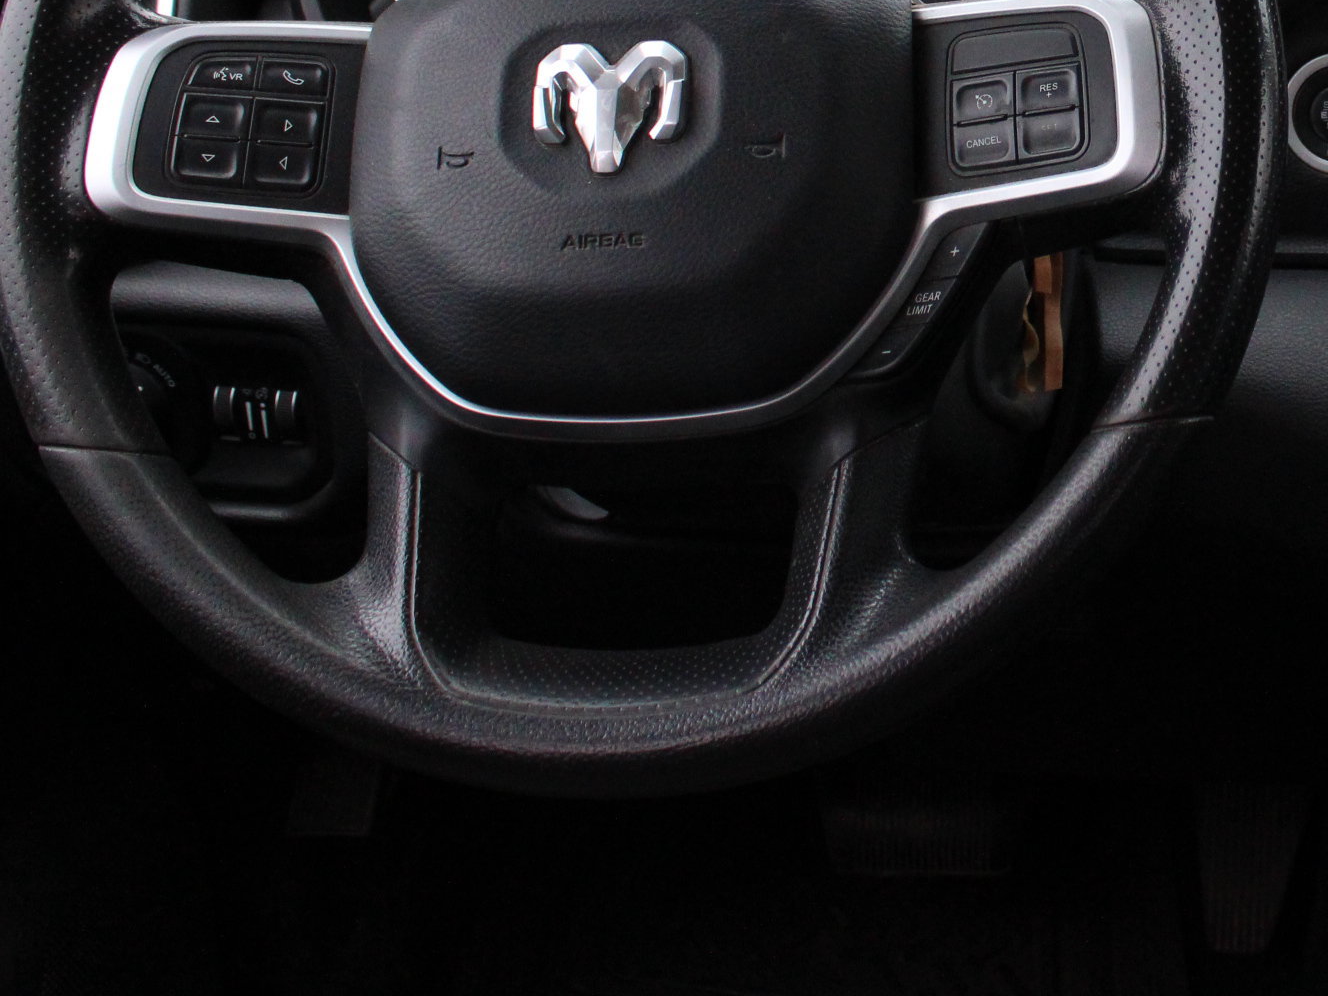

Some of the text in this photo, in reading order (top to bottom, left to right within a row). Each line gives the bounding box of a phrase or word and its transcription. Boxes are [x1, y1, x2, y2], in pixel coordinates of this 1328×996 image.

[229, 72, 243, 81] VR
[1039, 82, 1058, 92] RES
[966, 135, 1002, 149] CANCEL
[560, 232, 645, 251] AIRBAG
[915, 291, 942, 303] GEAR
[906, 304, 933, 316] LIMIT
